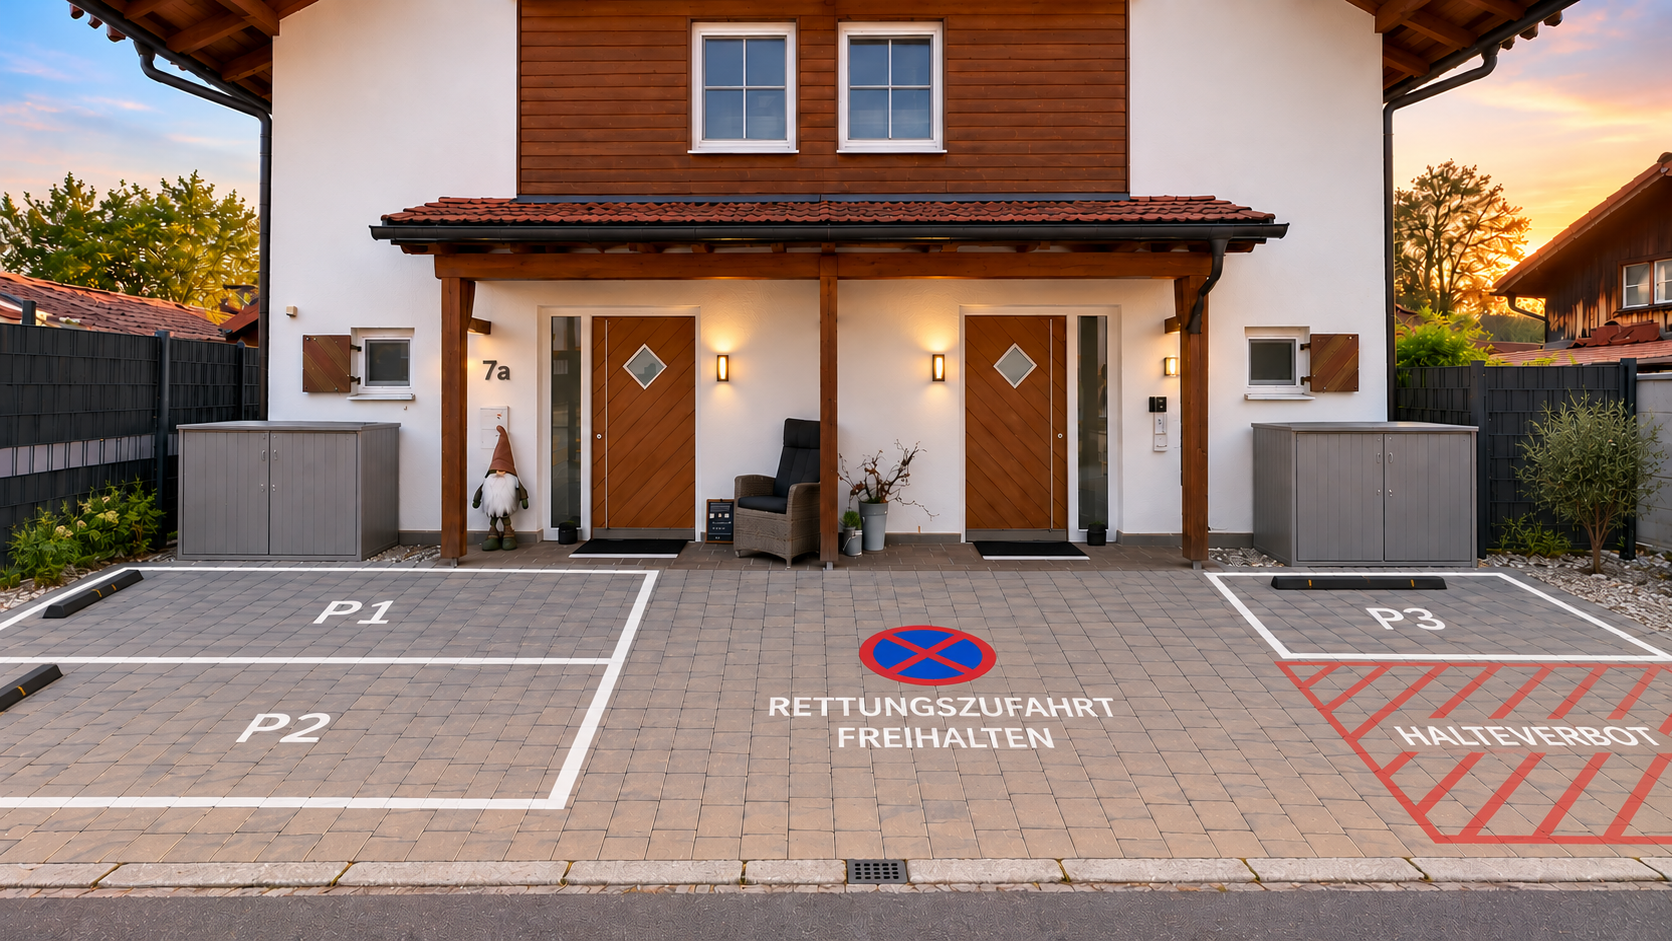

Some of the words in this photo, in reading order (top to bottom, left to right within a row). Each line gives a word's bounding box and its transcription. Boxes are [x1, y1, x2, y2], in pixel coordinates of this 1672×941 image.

[482, 360, 511, 381] 7a
[312, 600, 394, 625] P1
[1366, 607, 1446, 631] P3
[768, 697, 1114, 718] RETTUNGSZUFAHRT
[235, 712, 331, 743] P2
[838, 727, 1055, 749] FREIHALTEN
[1394, 725, 1660, 746] HALTEVERBOT
